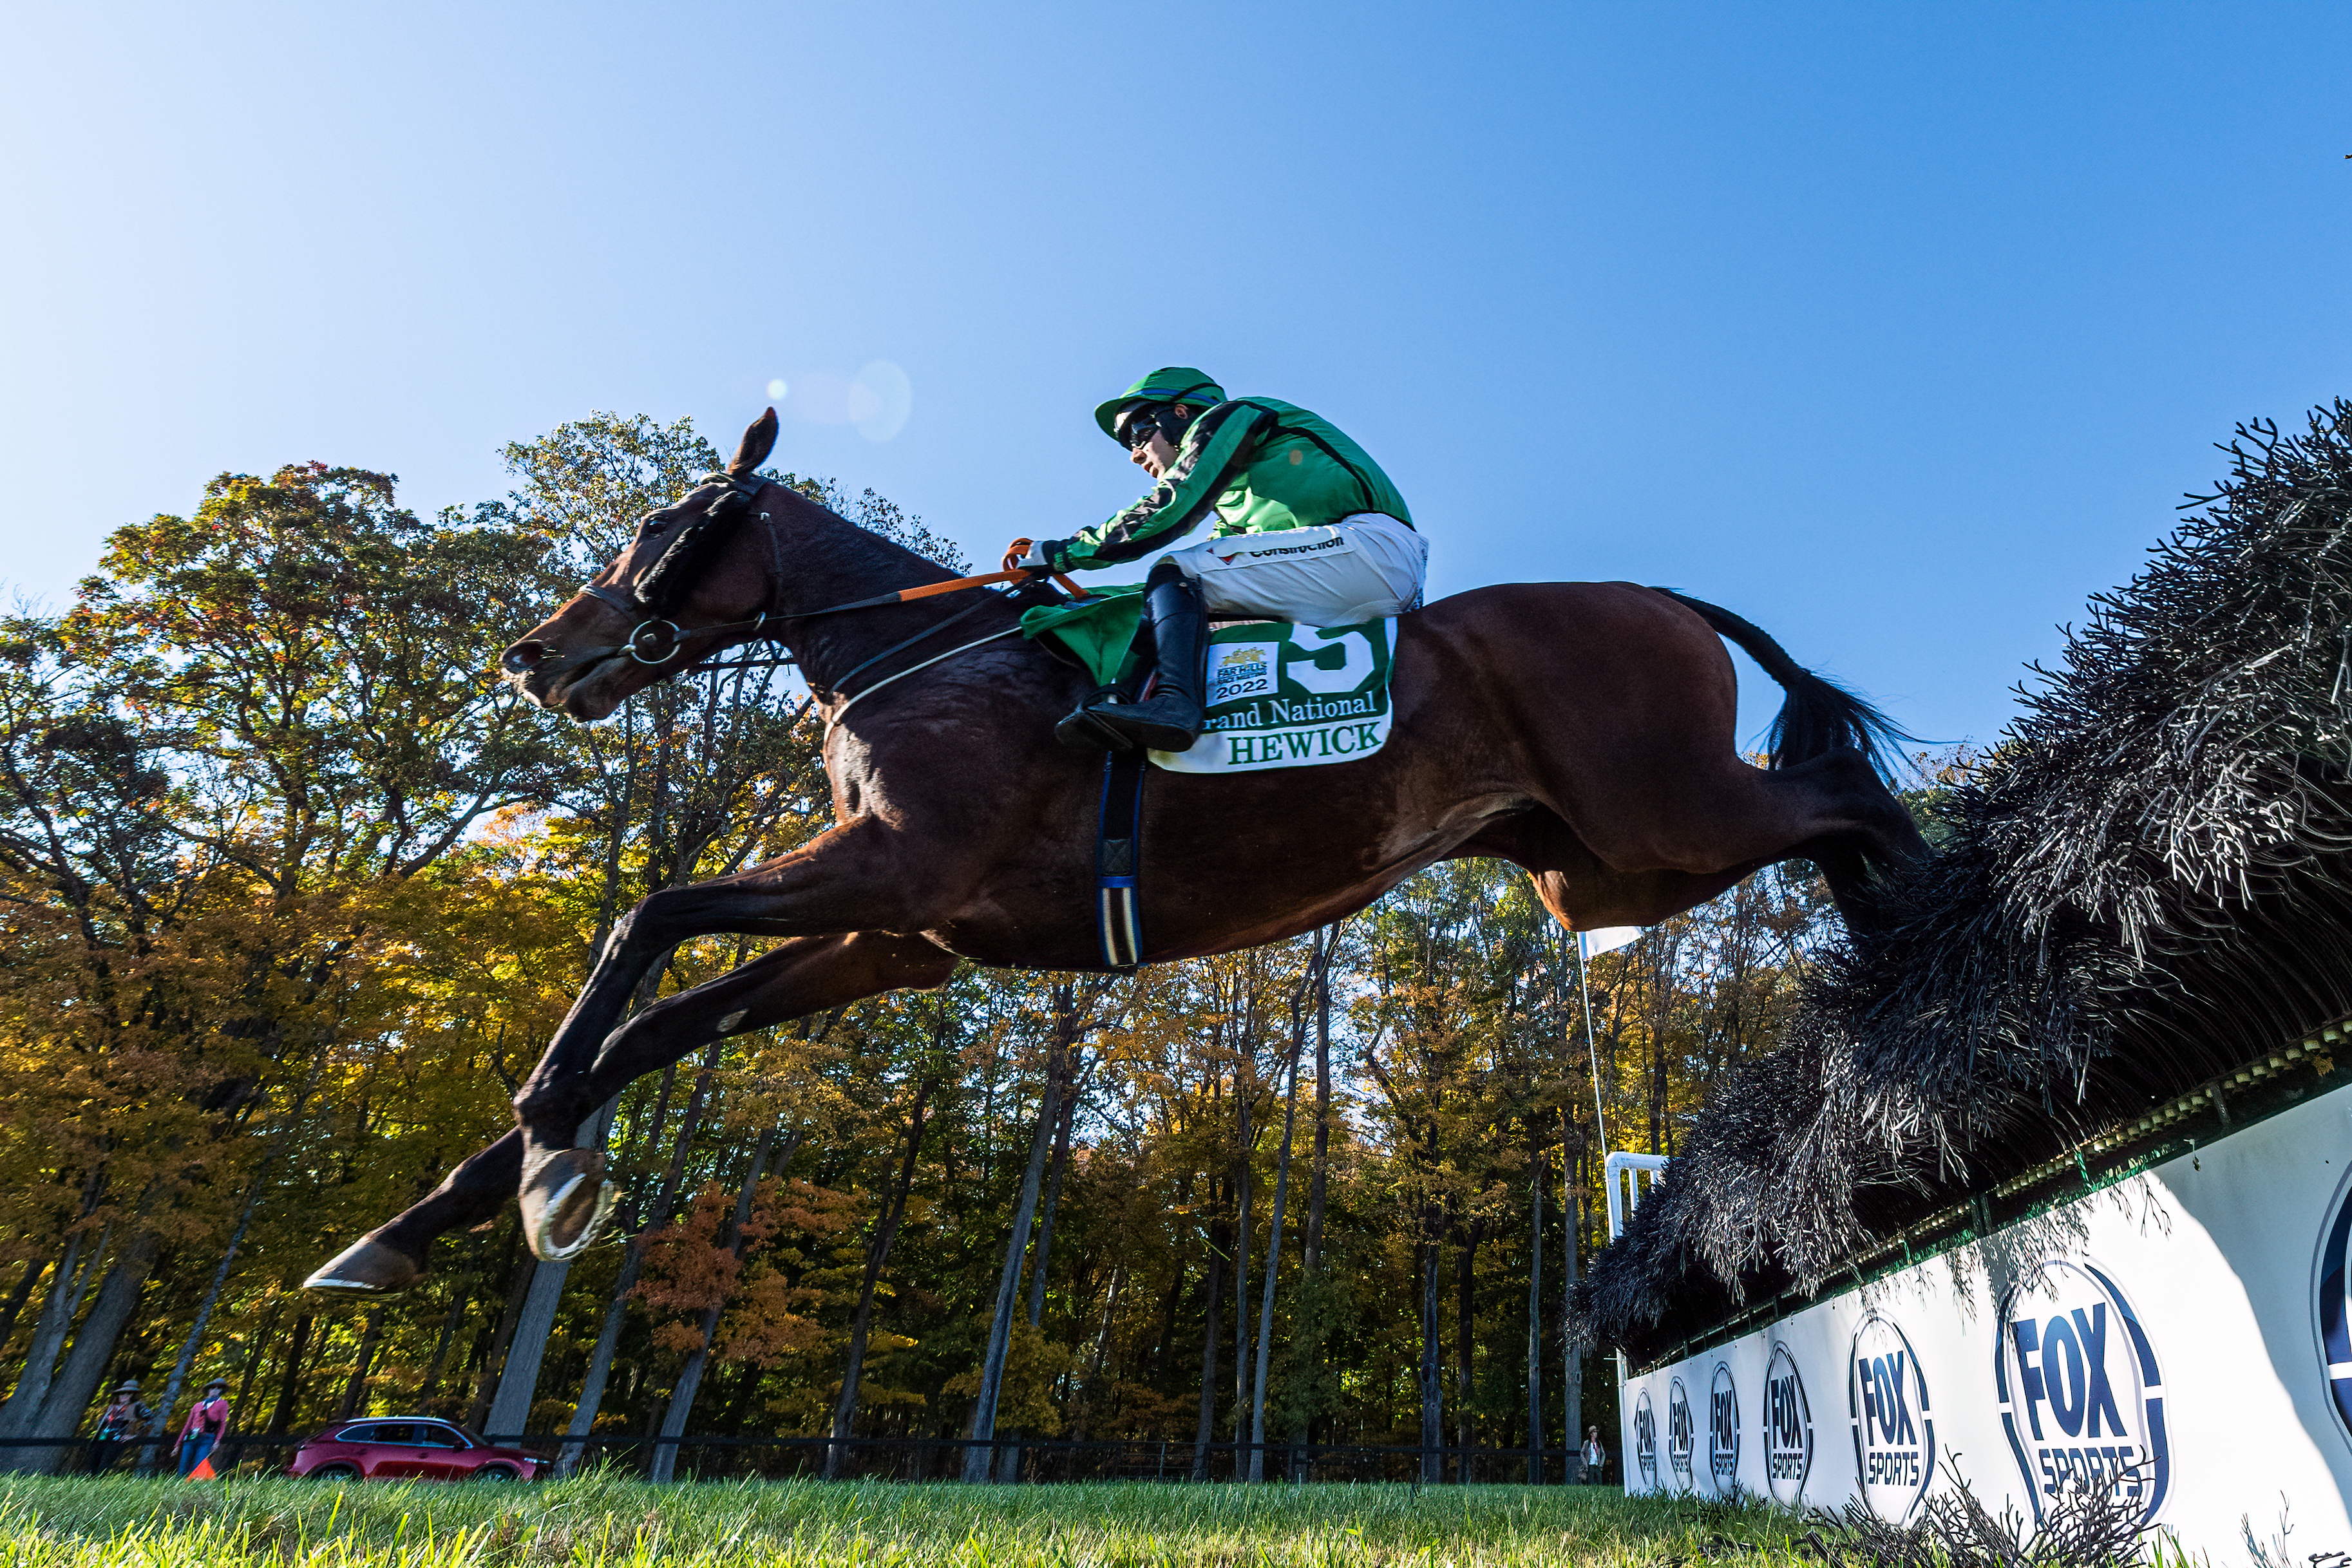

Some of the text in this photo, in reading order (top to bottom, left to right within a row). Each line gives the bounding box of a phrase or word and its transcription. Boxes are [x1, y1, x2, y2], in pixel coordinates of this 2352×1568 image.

[1287, 621, 1374, 694] 5
[1204, 692, 1378, 730] rand National
[1217, 679, 1268, 699] 2022
[1228, 721, 1382, 765] HEWICK
[2013, 1302, 2128, 1441] FOX
[1714, 1390, 1734, 1451] FOX
[1770, 1375, 1803, 1450] FOX
[1859, 1350, 1918, 1447] FOX
[1638, 1408, 1653, 1453] FOX
[1672, 1400, 1689, 1452] FOX
[1715, 1453, 1734, 1476] SPORTS
[1772, 1453, 1803, 1481] SPORTS
[1868, 1451, 1919, 1487] SPORTS
[2038, 1446, 2143, 1498] SPORTS
